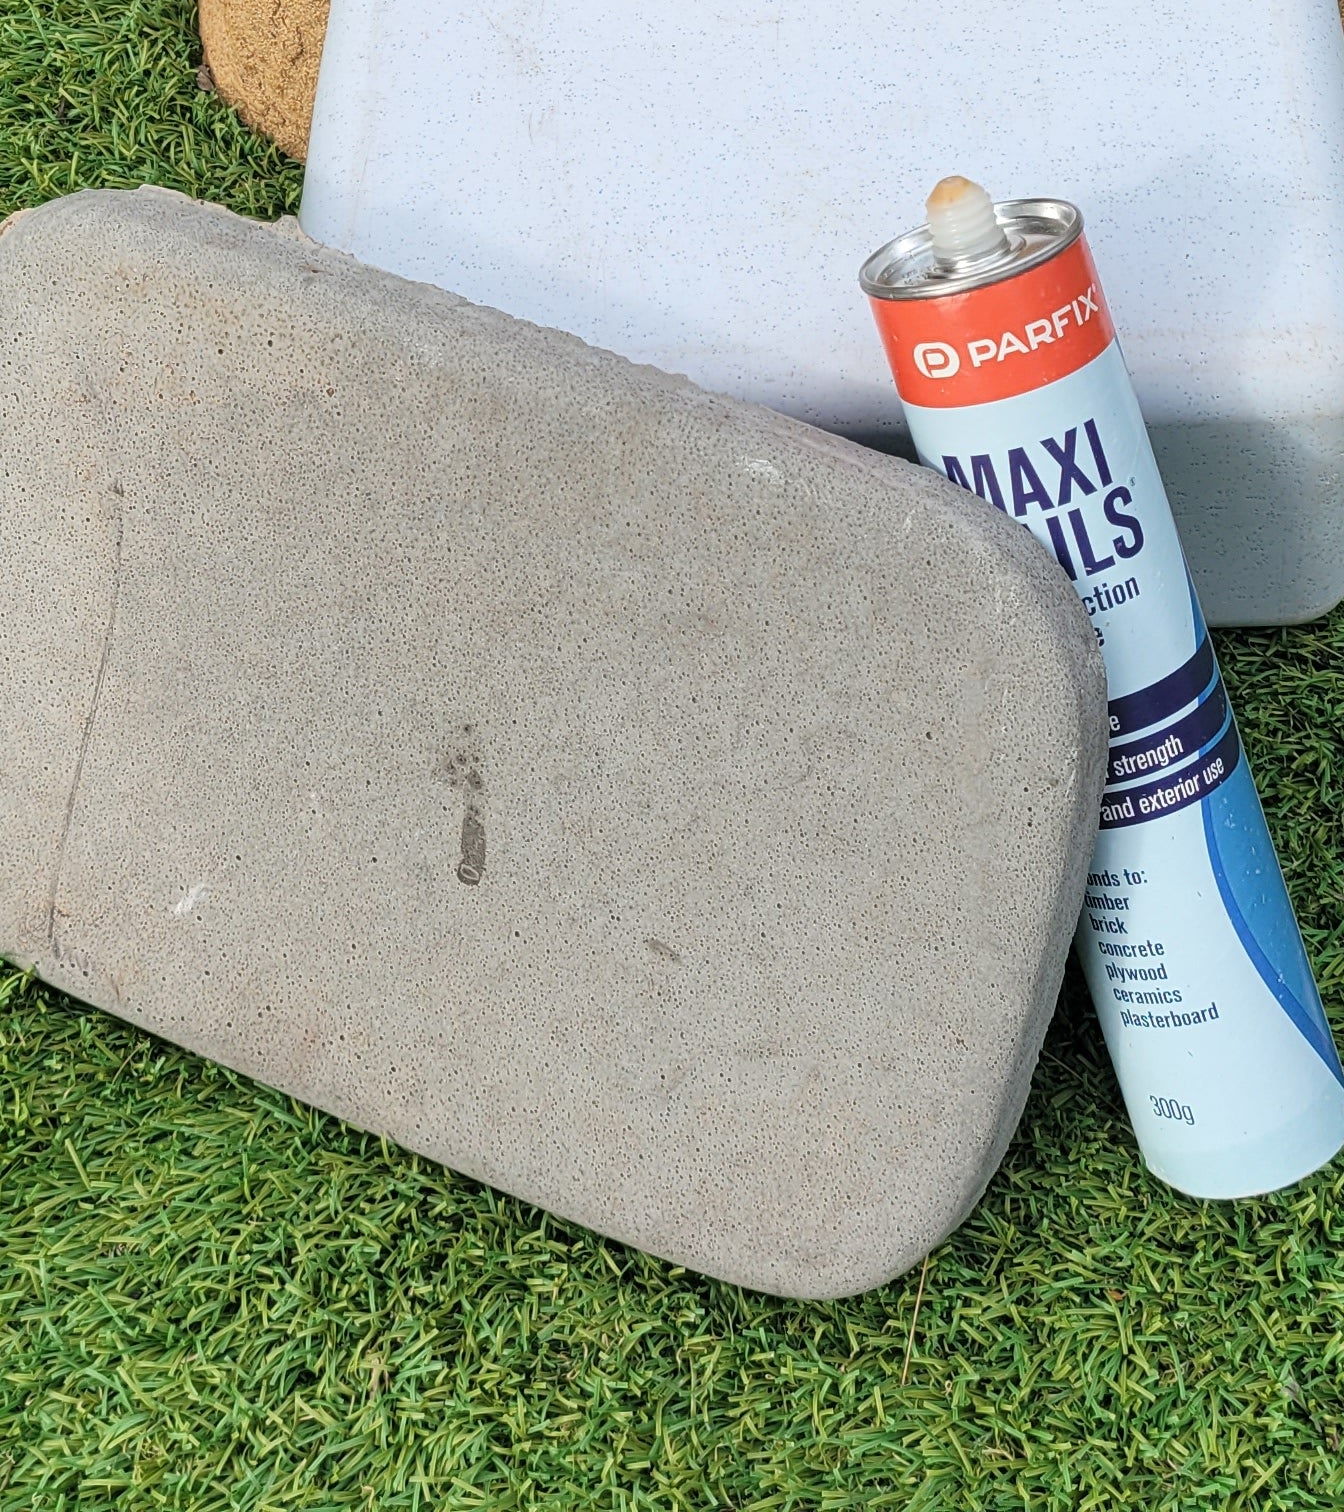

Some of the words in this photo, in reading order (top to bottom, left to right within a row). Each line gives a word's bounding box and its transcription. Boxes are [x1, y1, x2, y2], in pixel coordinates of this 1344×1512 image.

[967, 287, 1099, 368] PARFIX
[941, 417, 1113, 517] MAXI
[1022, 485, 1144, 581] ILS
[1113, 734, 1184, 777] strength
[1102, 796, 1136, 822] and
[1139, 774, 1201, 814] exterior
[1203, 757, 1225, 785] use
[1087, 870, 1121, 887] onds
[1124, 868, 1148, 886] to:
[1088, 913, 1128, 934] brick
[1098, 940, 1165, 958] concrete
[1105, 963, 1168, 983] plywood
[1113, 987, 1183, 1005] ceramics
[1120, 1001, 1220, 1028] plasterboard
[1149, 1094, 1195, 1126] 300g
